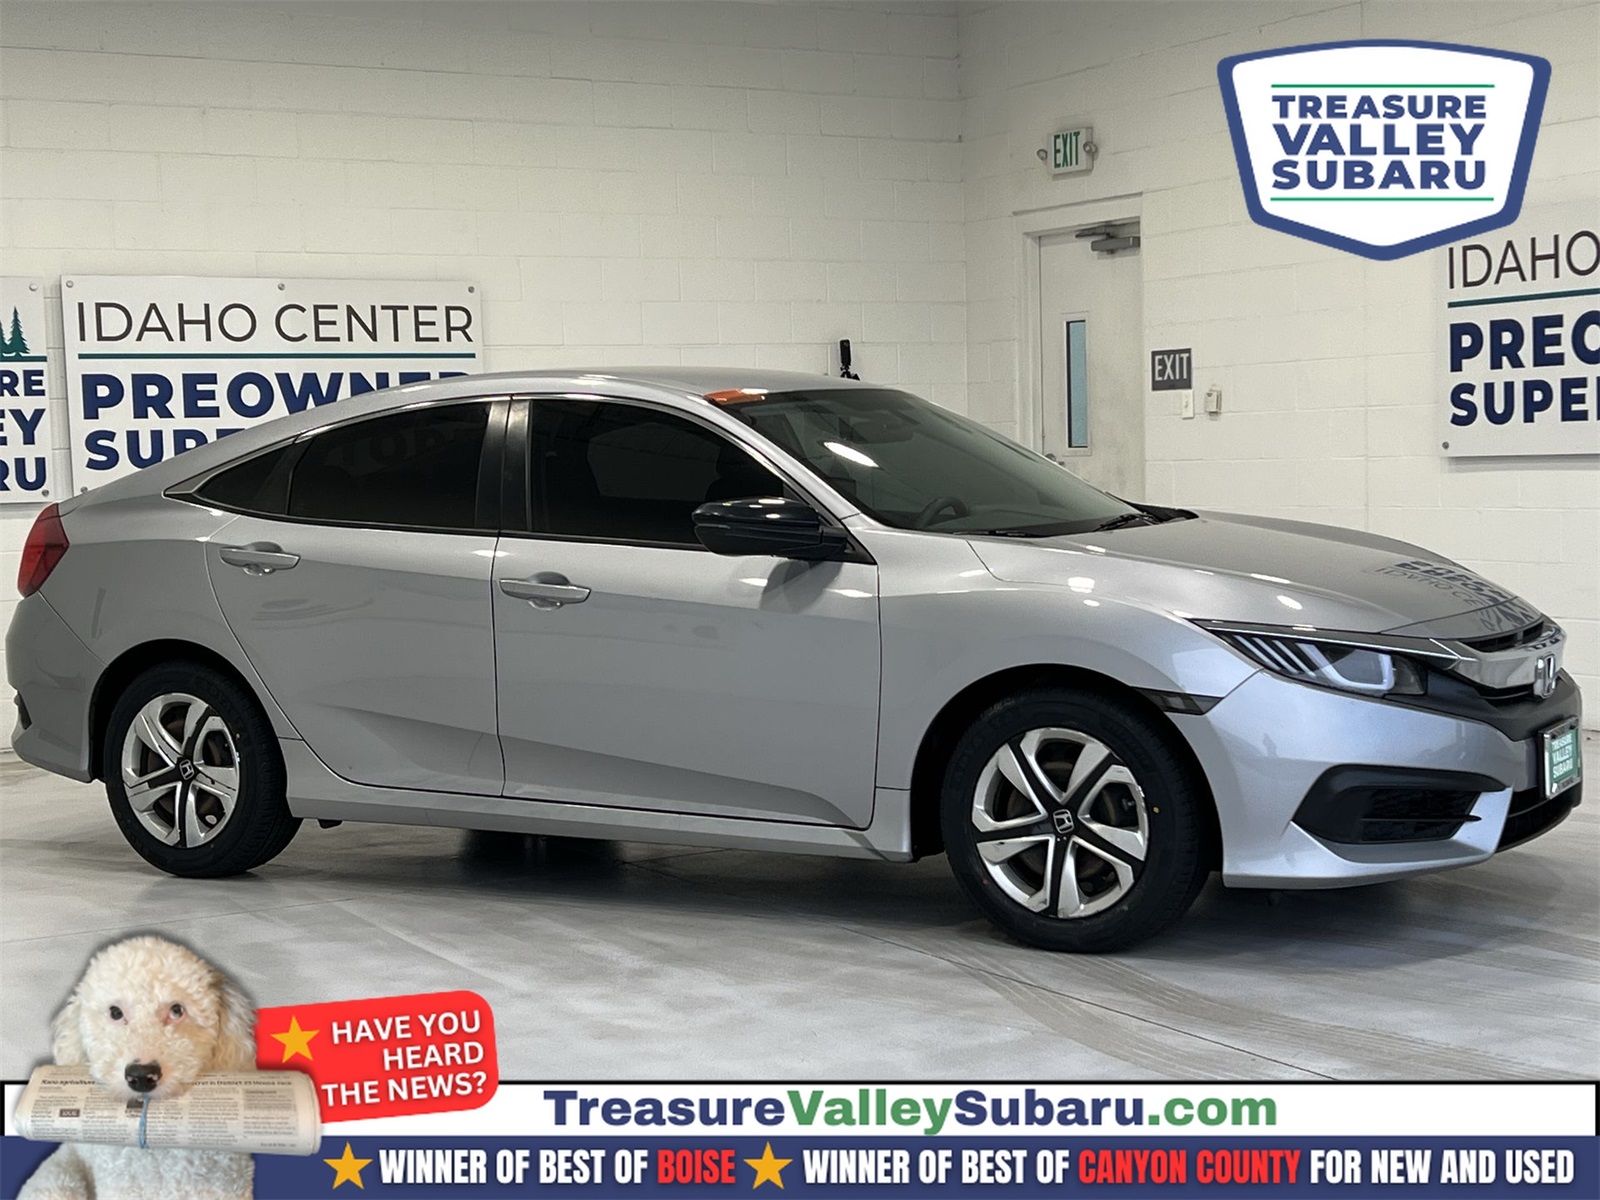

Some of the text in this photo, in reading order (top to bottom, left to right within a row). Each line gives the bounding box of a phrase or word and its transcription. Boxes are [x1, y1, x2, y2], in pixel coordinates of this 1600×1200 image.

[1053, 131, 1081, 169] EXIT
[1448, 230, 1600, 290] IDAHO
[77, 301, 474, 343] IDAHO CENTER
[1154, 352, 1190, 381] EXIT
[1449, 376, 1600, 427] SUPE
